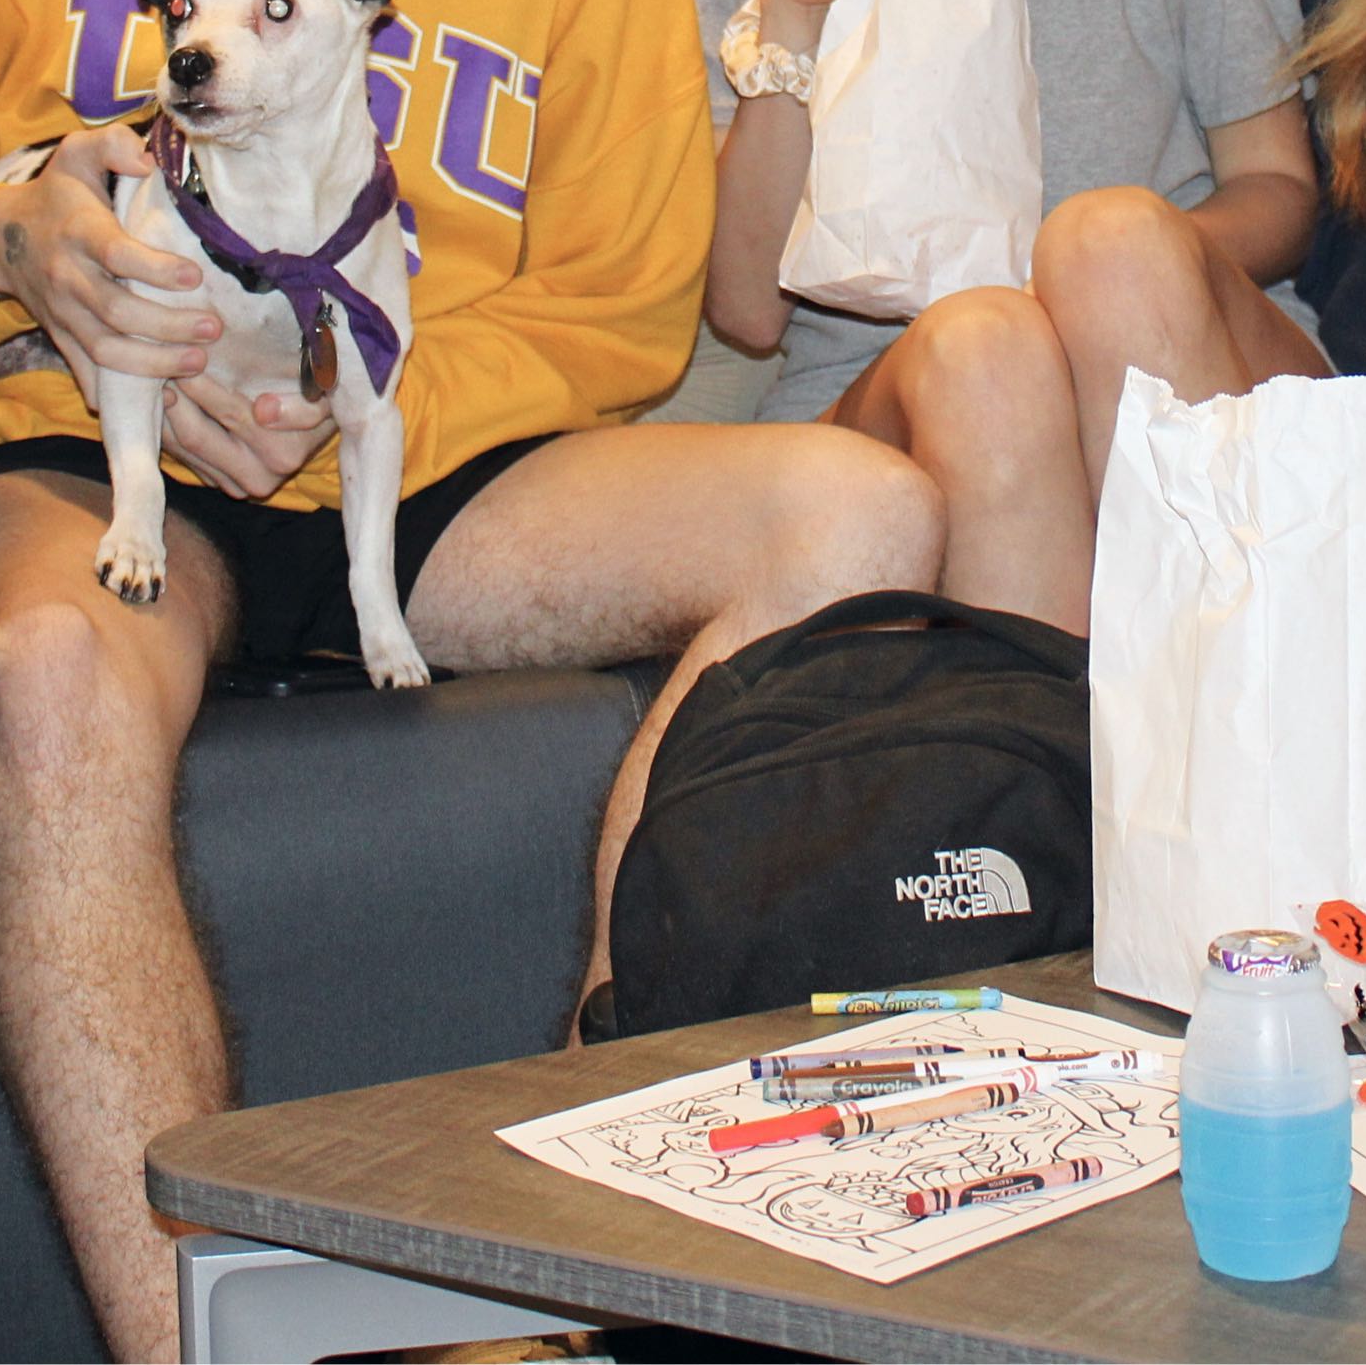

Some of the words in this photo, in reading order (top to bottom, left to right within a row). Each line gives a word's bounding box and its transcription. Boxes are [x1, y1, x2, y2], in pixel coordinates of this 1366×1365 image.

[934, 849, 982, 874] THE
[894, 870, 983, 902] NORTH
[923, 892, 989, 922] FACE
[838, 1077, 914, 1097] Crayola
